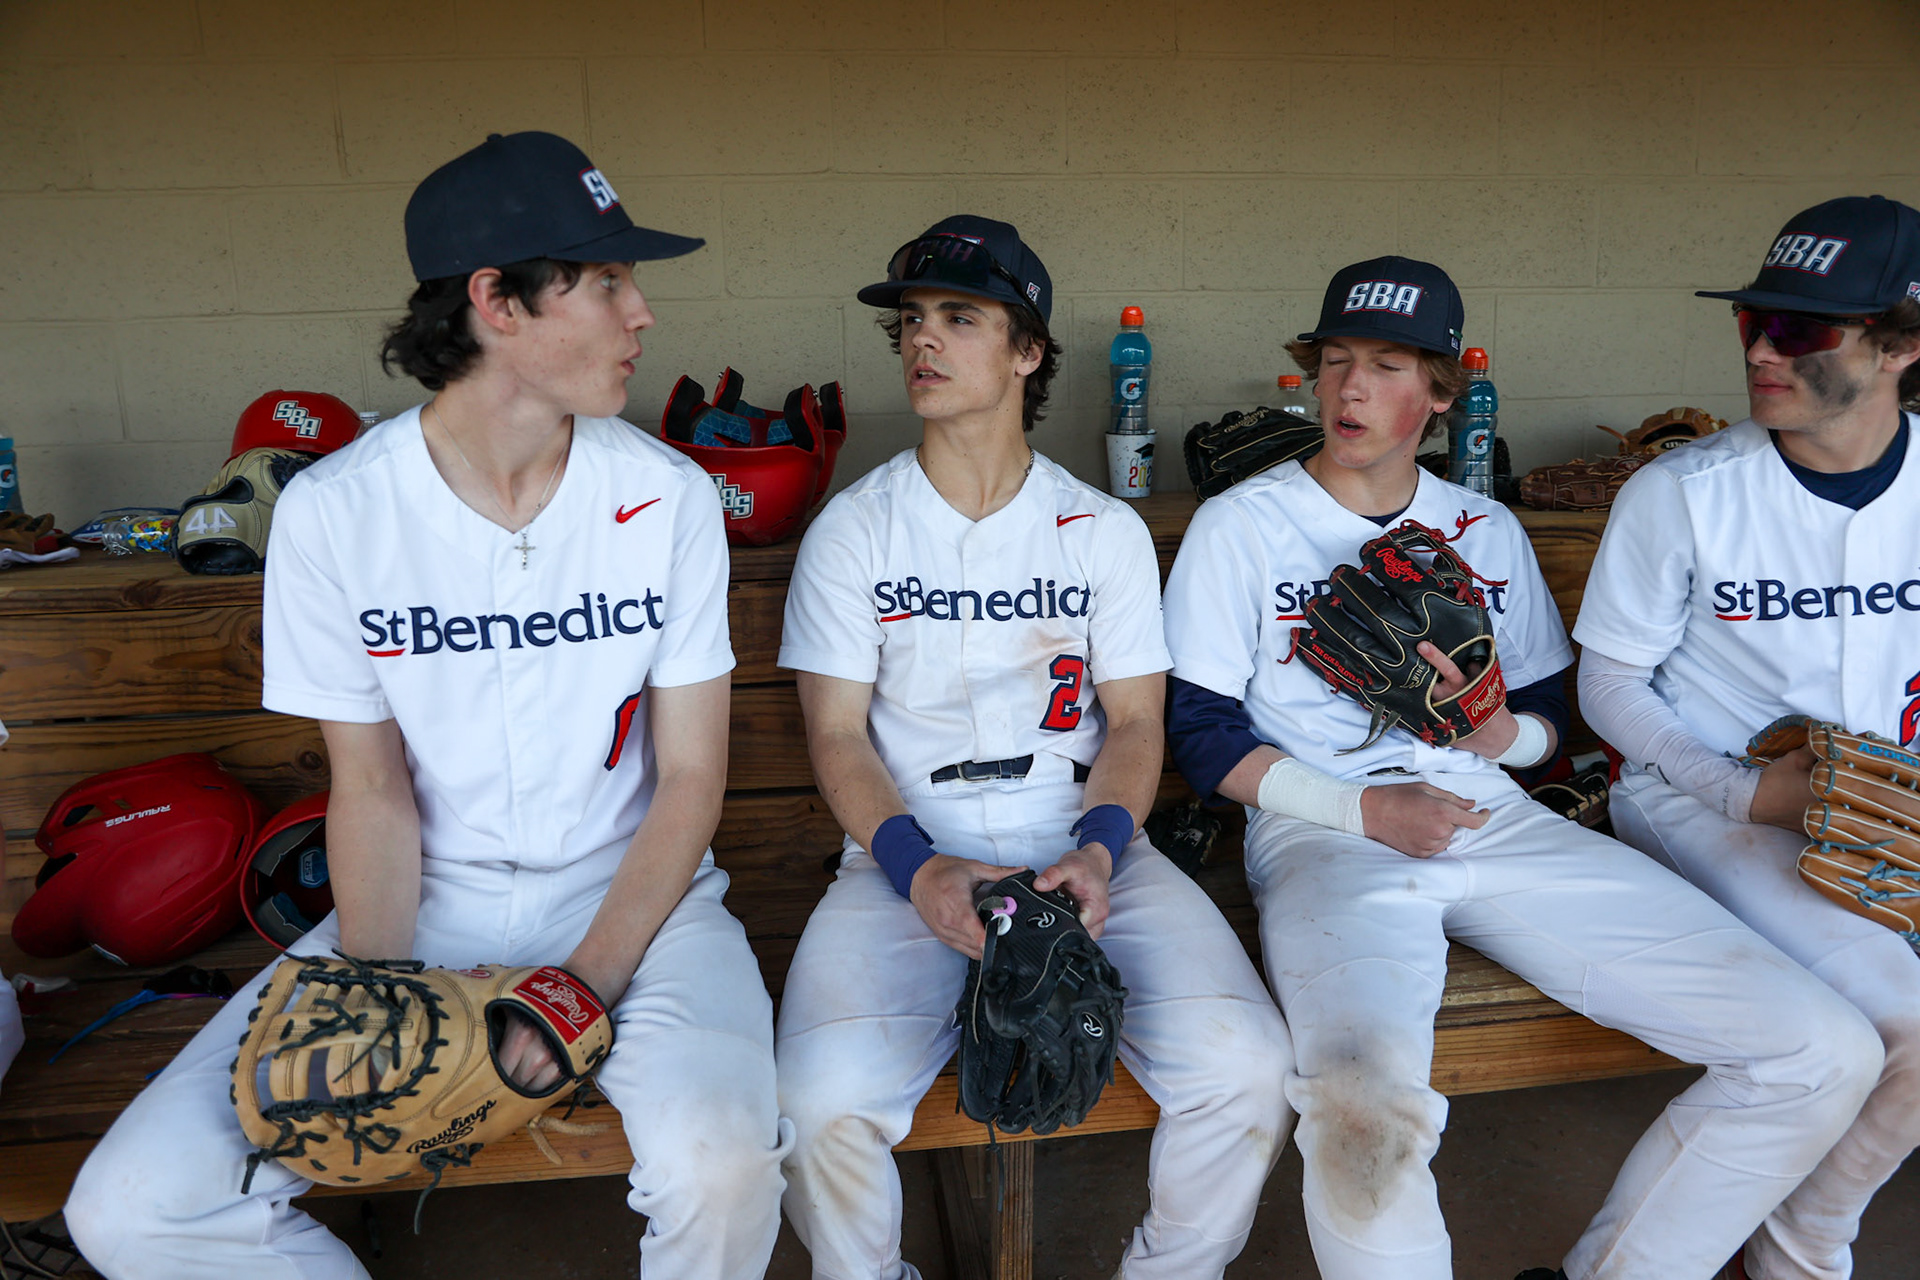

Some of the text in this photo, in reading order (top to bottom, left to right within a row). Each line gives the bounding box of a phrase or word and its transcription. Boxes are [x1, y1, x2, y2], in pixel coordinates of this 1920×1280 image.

[1764, 233, 1849, 276] SBA
[1343, 280, 1422, 316] SBA
[273, 400, 322, 439] SBA
[184, 506, 238, 535] 44
[1376, 547, 1424, 583] Rawlings
[1323, 653, 1340, 667] GOLD
[1411, 664, 1425, 682] WING
[1039, 654, 1084, 732] 2
[1857, 742, 1920, 768] A2000
[104, 803, 171, 828] RAWLINGS
[530, 981, 590, 1023] Rawlings
[406, 1099, 497, 1153] Rawlings
